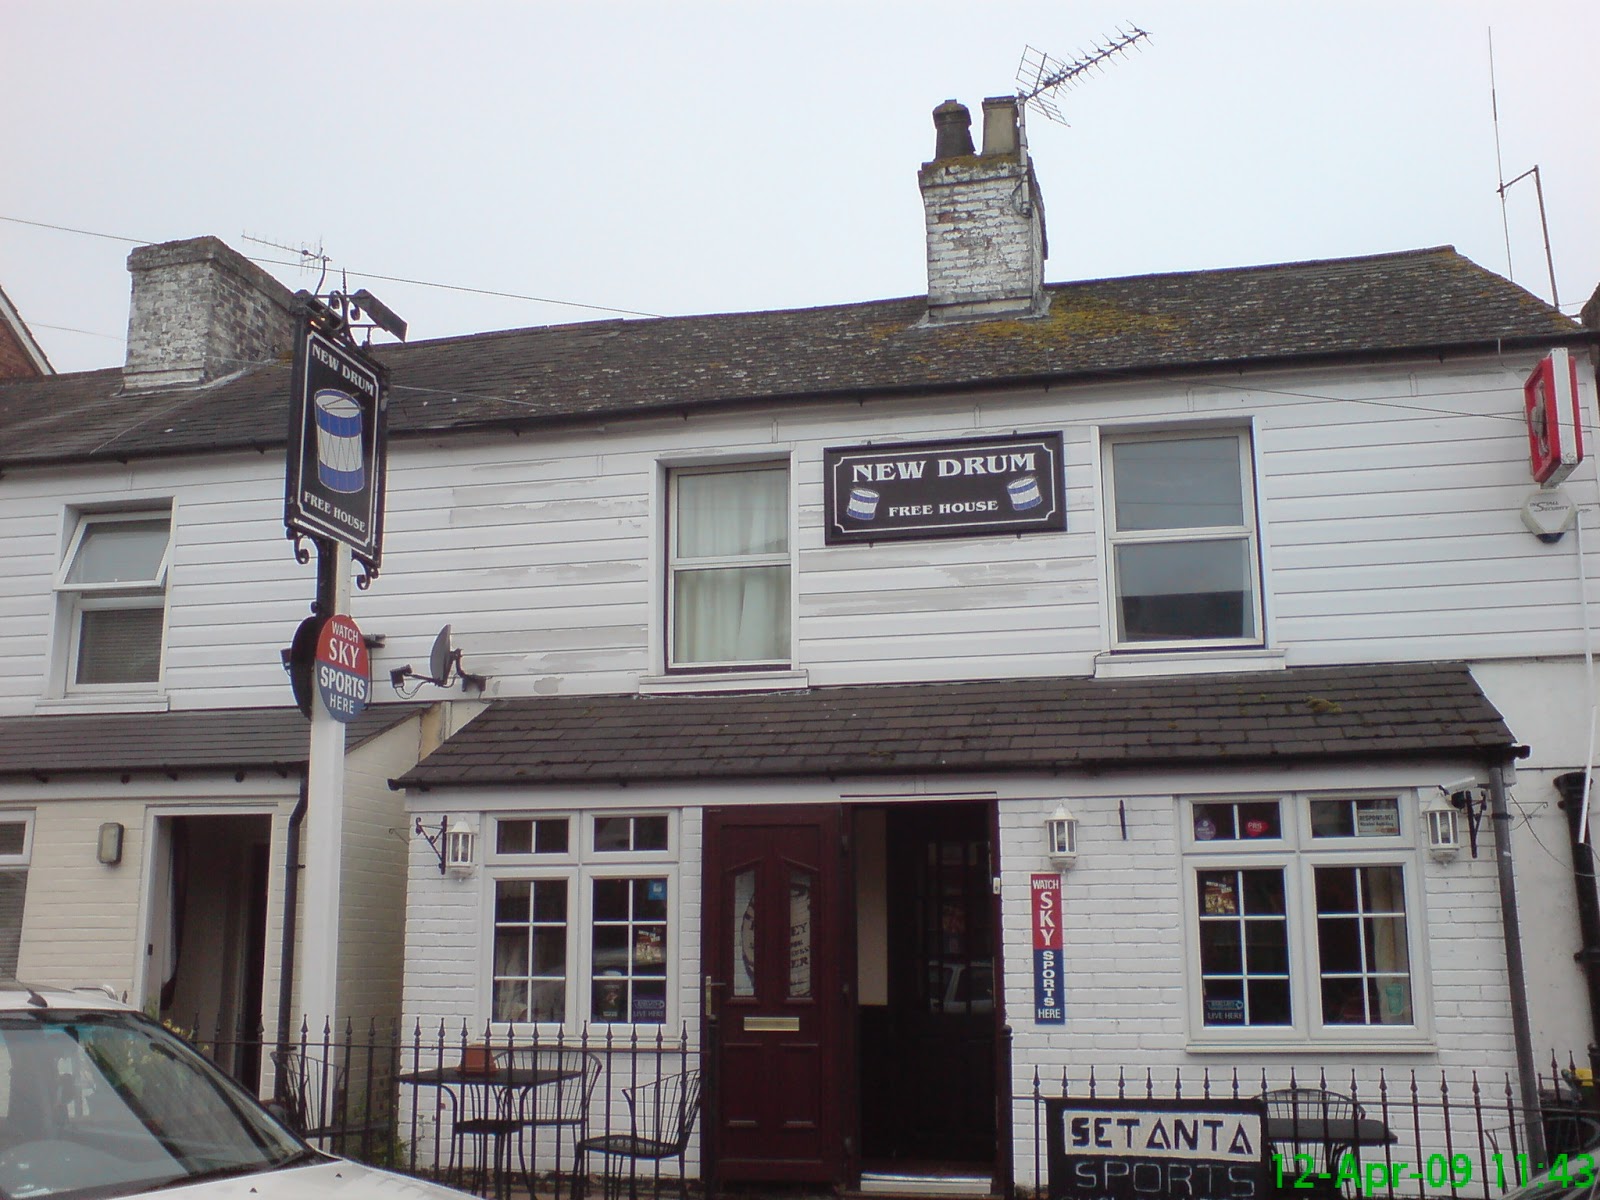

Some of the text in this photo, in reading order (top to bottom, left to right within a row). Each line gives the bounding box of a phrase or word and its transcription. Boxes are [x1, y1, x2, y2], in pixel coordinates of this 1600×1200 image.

[312, 343, 374, 397] NEW DRUM
[852, 452, 1036, 483] NEW DRUM
[304, 490, 366, 533] FREE HOUSE
[888, 500, 999, 518] FREE HOUSE
[331, 620, 359, 643] WATCH
[329, 637, 360, 669] SKY
[320, 665, 365, 700] SPORTS
[329, 693, 355, 715] HERE
[1032, 879, 1059, 890] WATCH
[1039, 891, 1056, 946] SKY
[1042, 950, 1056, 1007] SPORTS
[1038, 1008, 1061, 1019] HERE
[1071, 1116, 1253, 1155] SETANTA
[1075, 1160, 1255, 1197] SPORTS
